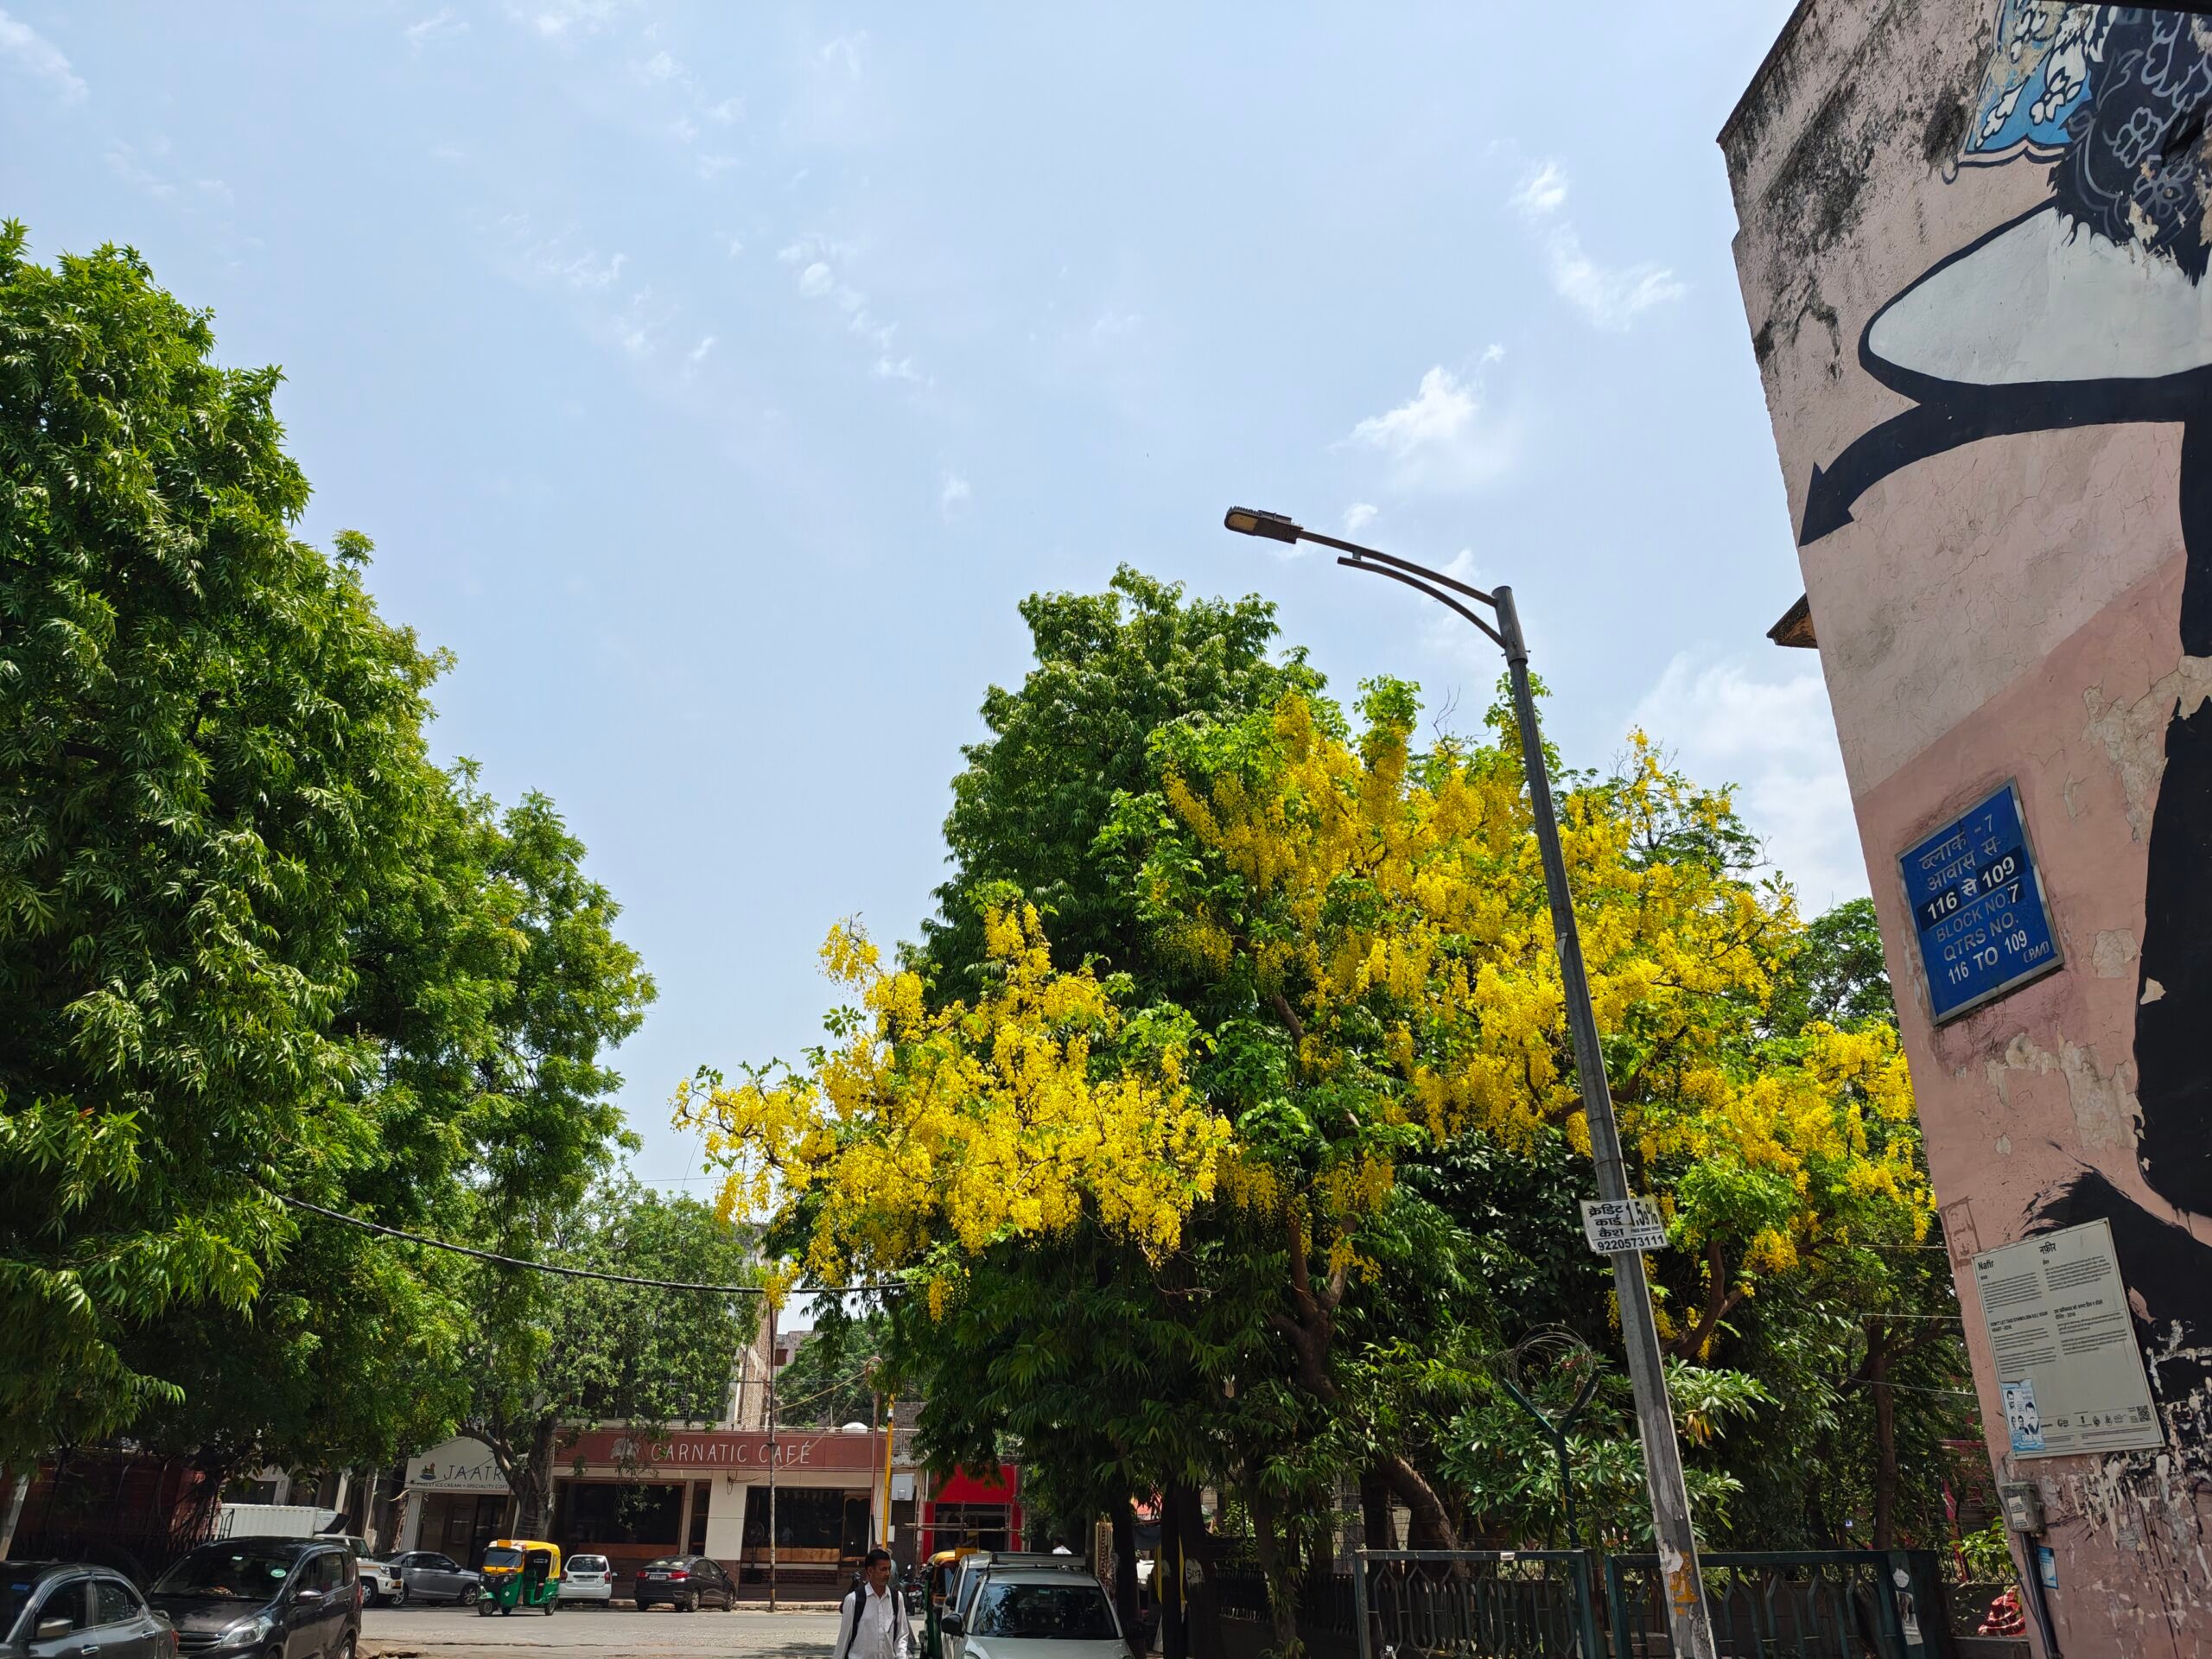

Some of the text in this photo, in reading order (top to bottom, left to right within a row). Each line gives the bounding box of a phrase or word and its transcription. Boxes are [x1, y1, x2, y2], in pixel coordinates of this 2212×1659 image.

[1927, 850, 1976, 891] आवास
[1928, 856, 2015, 920] 116 से 109
[1936, 905, 1983, 943] BLOCK
[1943, 912, 2019, 962] QTRS NO.
[1948, 930, 2028, 985] 116 TO 109
[1587, 1203, 1624, 1217] क्रेडिट
[1593, 1214, 1623, 1227] कार्ड
[1597, 1234, 1664, 1251] 9220573111
[1598, 1228, 1624, 1238] कैश
[1978, 1259, 1994, 1271] Nafir
[651, 1440, 811, 1464] CARNATIC CAFÉ
[443, 1465, 505, 1481] JAATR
